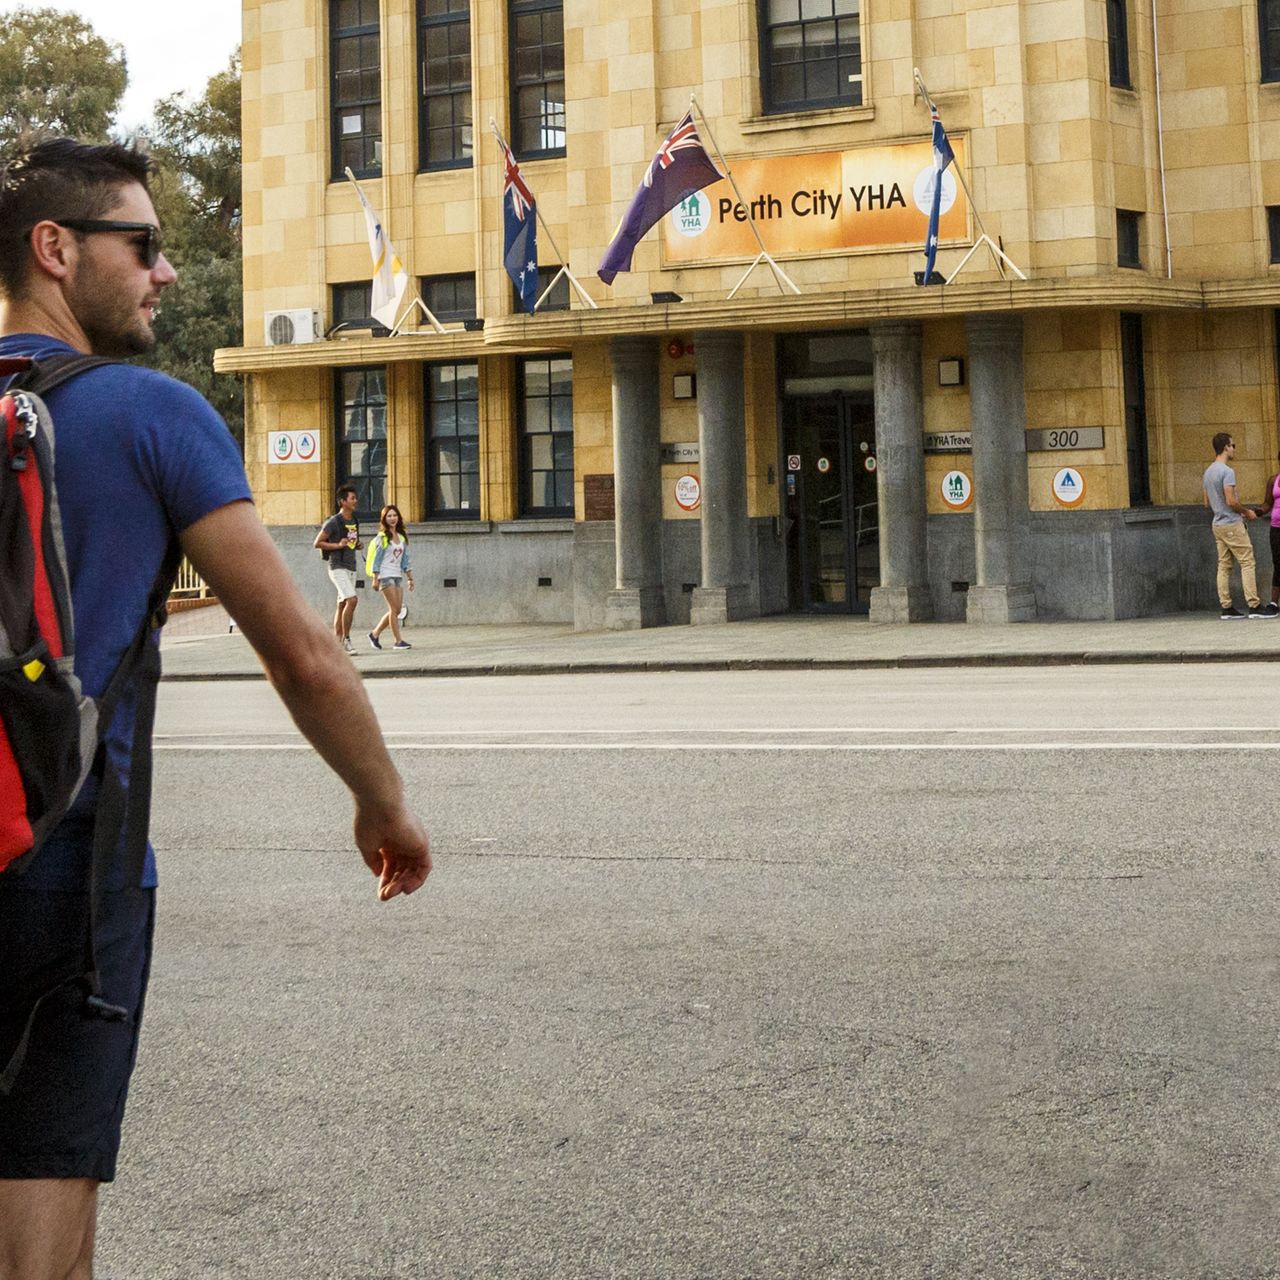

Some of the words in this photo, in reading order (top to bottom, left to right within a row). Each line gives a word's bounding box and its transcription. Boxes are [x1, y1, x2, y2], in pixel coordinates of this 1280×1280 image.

[719, 193, 783, 223] Perth
[791, 189, 842, 220] City
[850, 182, 907, 212] YHA
[681, 218, 701, 227] YHA
[933, 435, 949, 446] YHA
[950, 434, 973, 445] Trave
[1048, 430, 1079, 448] 300
